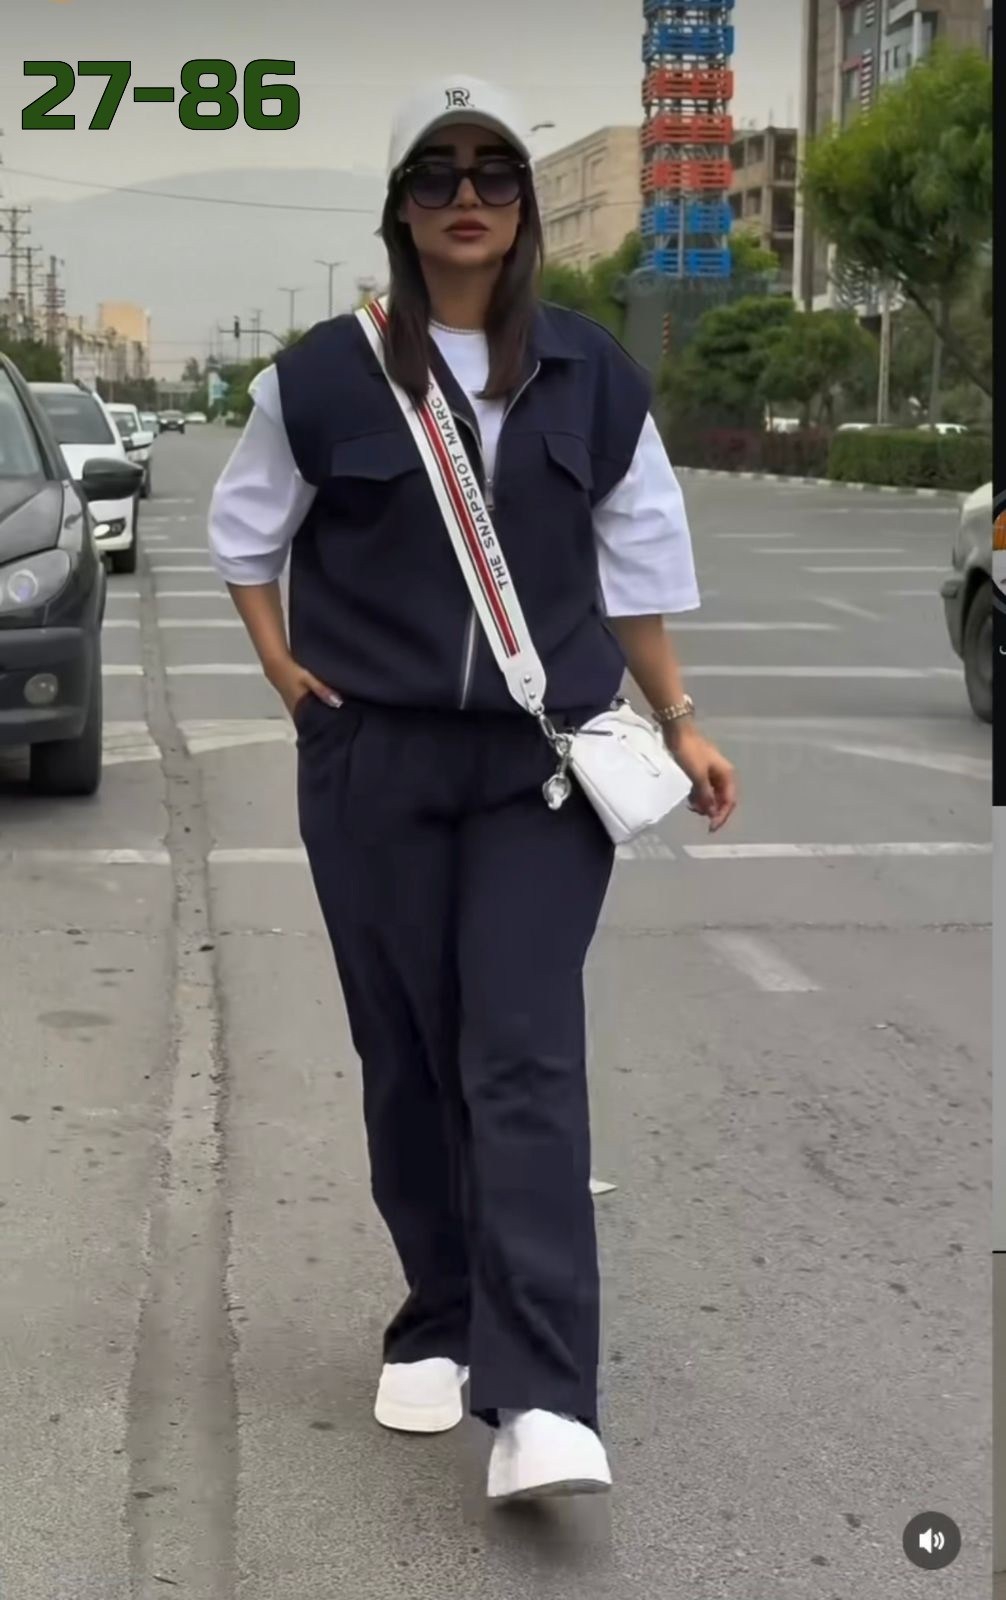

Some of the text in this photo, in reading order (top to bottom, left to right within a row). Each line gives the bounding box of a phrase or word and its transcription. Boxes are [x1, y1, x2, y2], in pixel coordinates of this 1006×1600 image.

[430, 396, 509, 591] THE SNAPSHOT MARC
